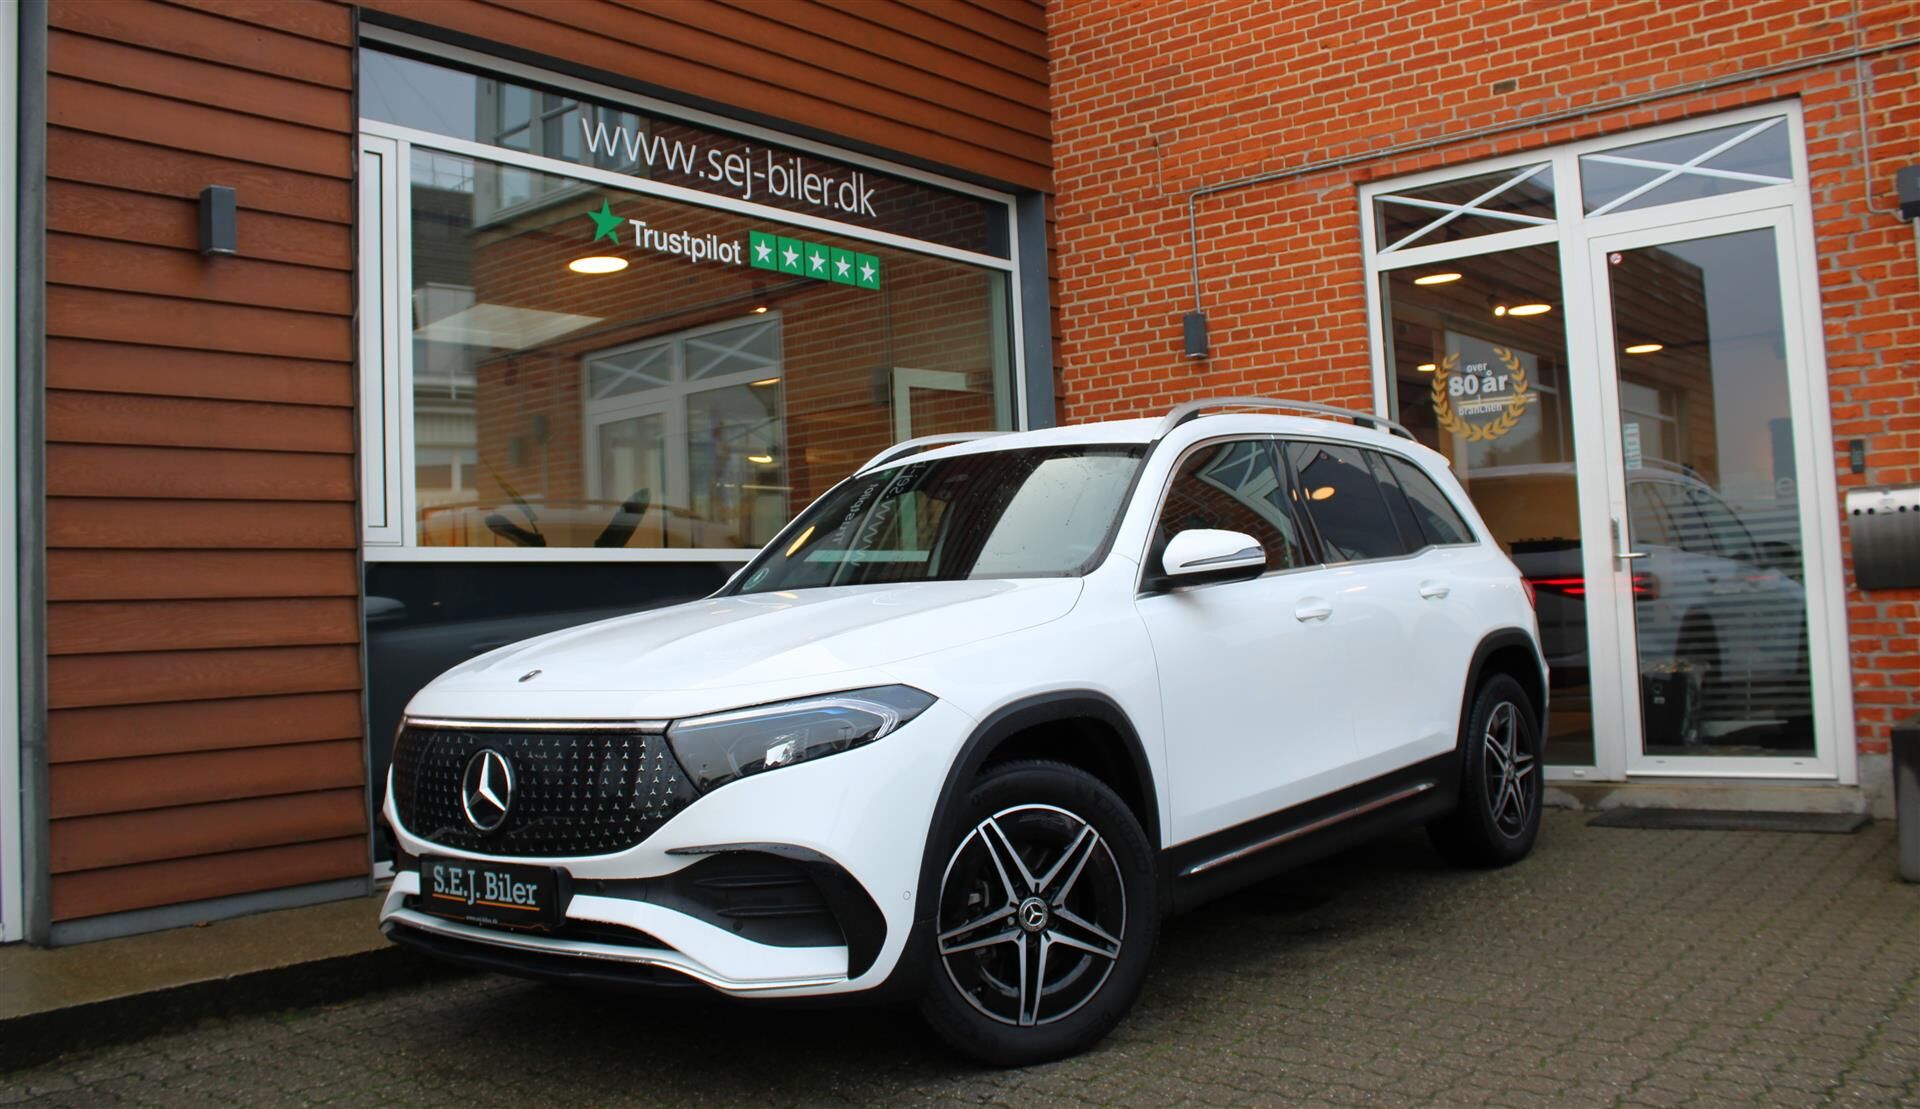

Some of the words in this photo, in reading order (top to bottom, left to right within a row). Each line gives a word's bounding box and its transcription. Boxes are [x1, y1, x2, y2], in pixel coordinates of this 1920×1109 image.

[582, 117, 877, 218] www.sej-biler.dk
[629, 219, 741, 265] Trustpilot
[1448, 374, 1479, 397] 80
[1482, 370, 1508, 393] år
[1466, 362, 1488, 373] over
[433, 865, 480, 905] S.E.J.
[484, 871, 537, 905] Biler
